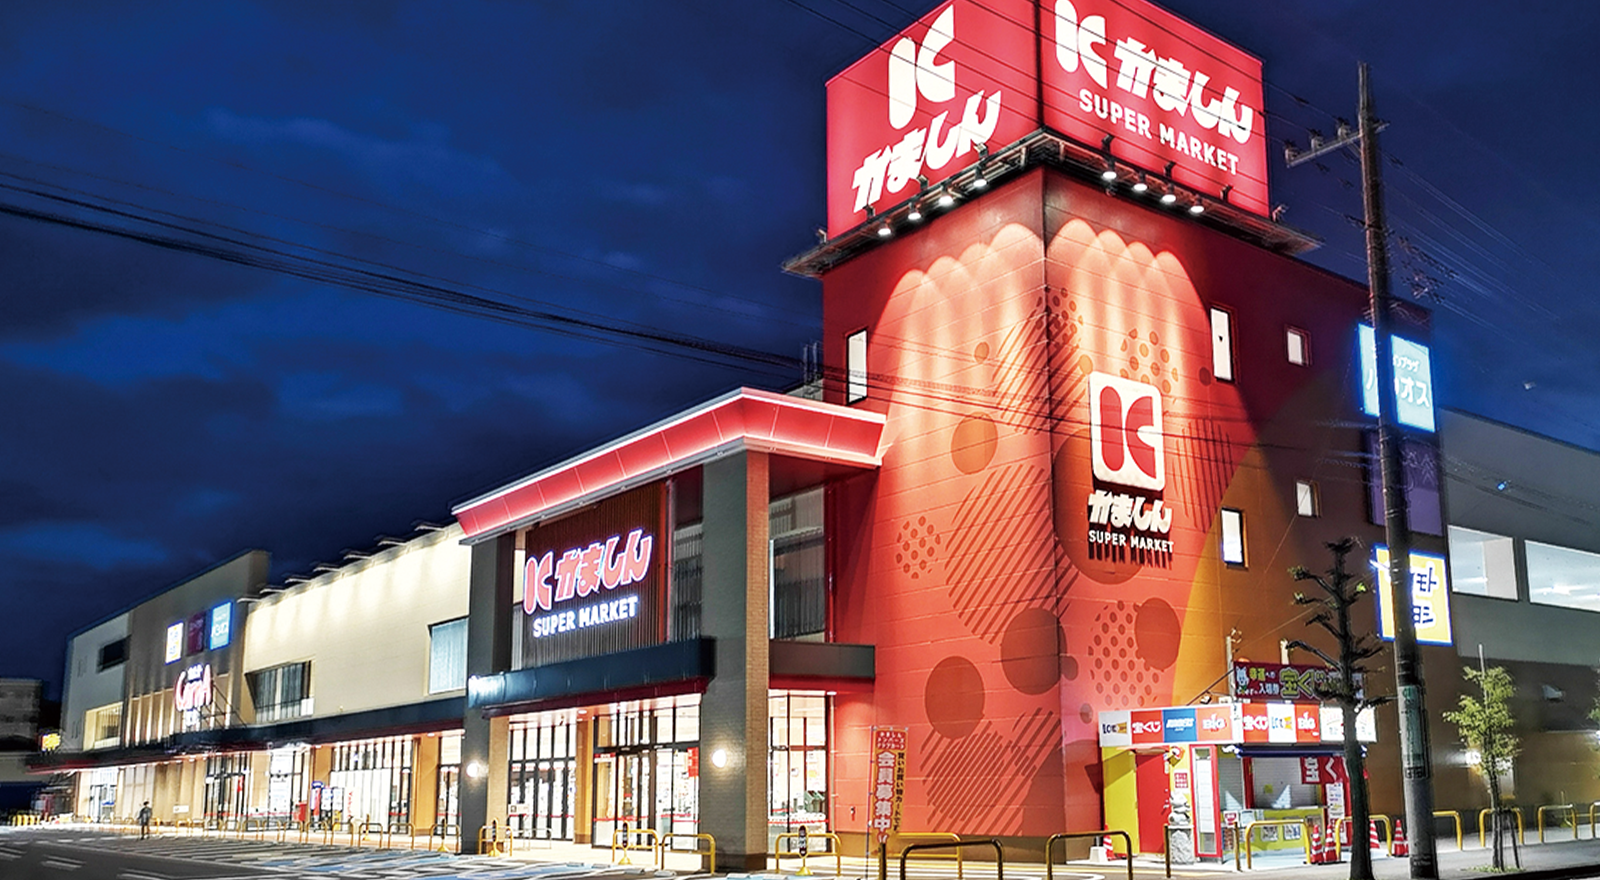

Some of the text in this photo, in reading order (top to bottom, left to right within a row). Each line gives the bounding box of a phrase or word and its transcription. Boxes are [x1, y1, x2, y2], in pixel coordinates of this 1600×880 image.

[1113, 36, 1254, 144] かましん
[852, 90, 1001, 212] かましん
[1078, 88, 1240, 176] SUPER MARKET
[1087, 489, 1173, 534] かましん
[1088, 529, 1174, 553] SUPER MARKET
[554, 528, 653, 603] かましん
[532, 595, 639, 638] SUPER MARKET
[1131, 720, 1162, 734] 宝くじ
[1242, 715, 1269, 731] 宝くじ
